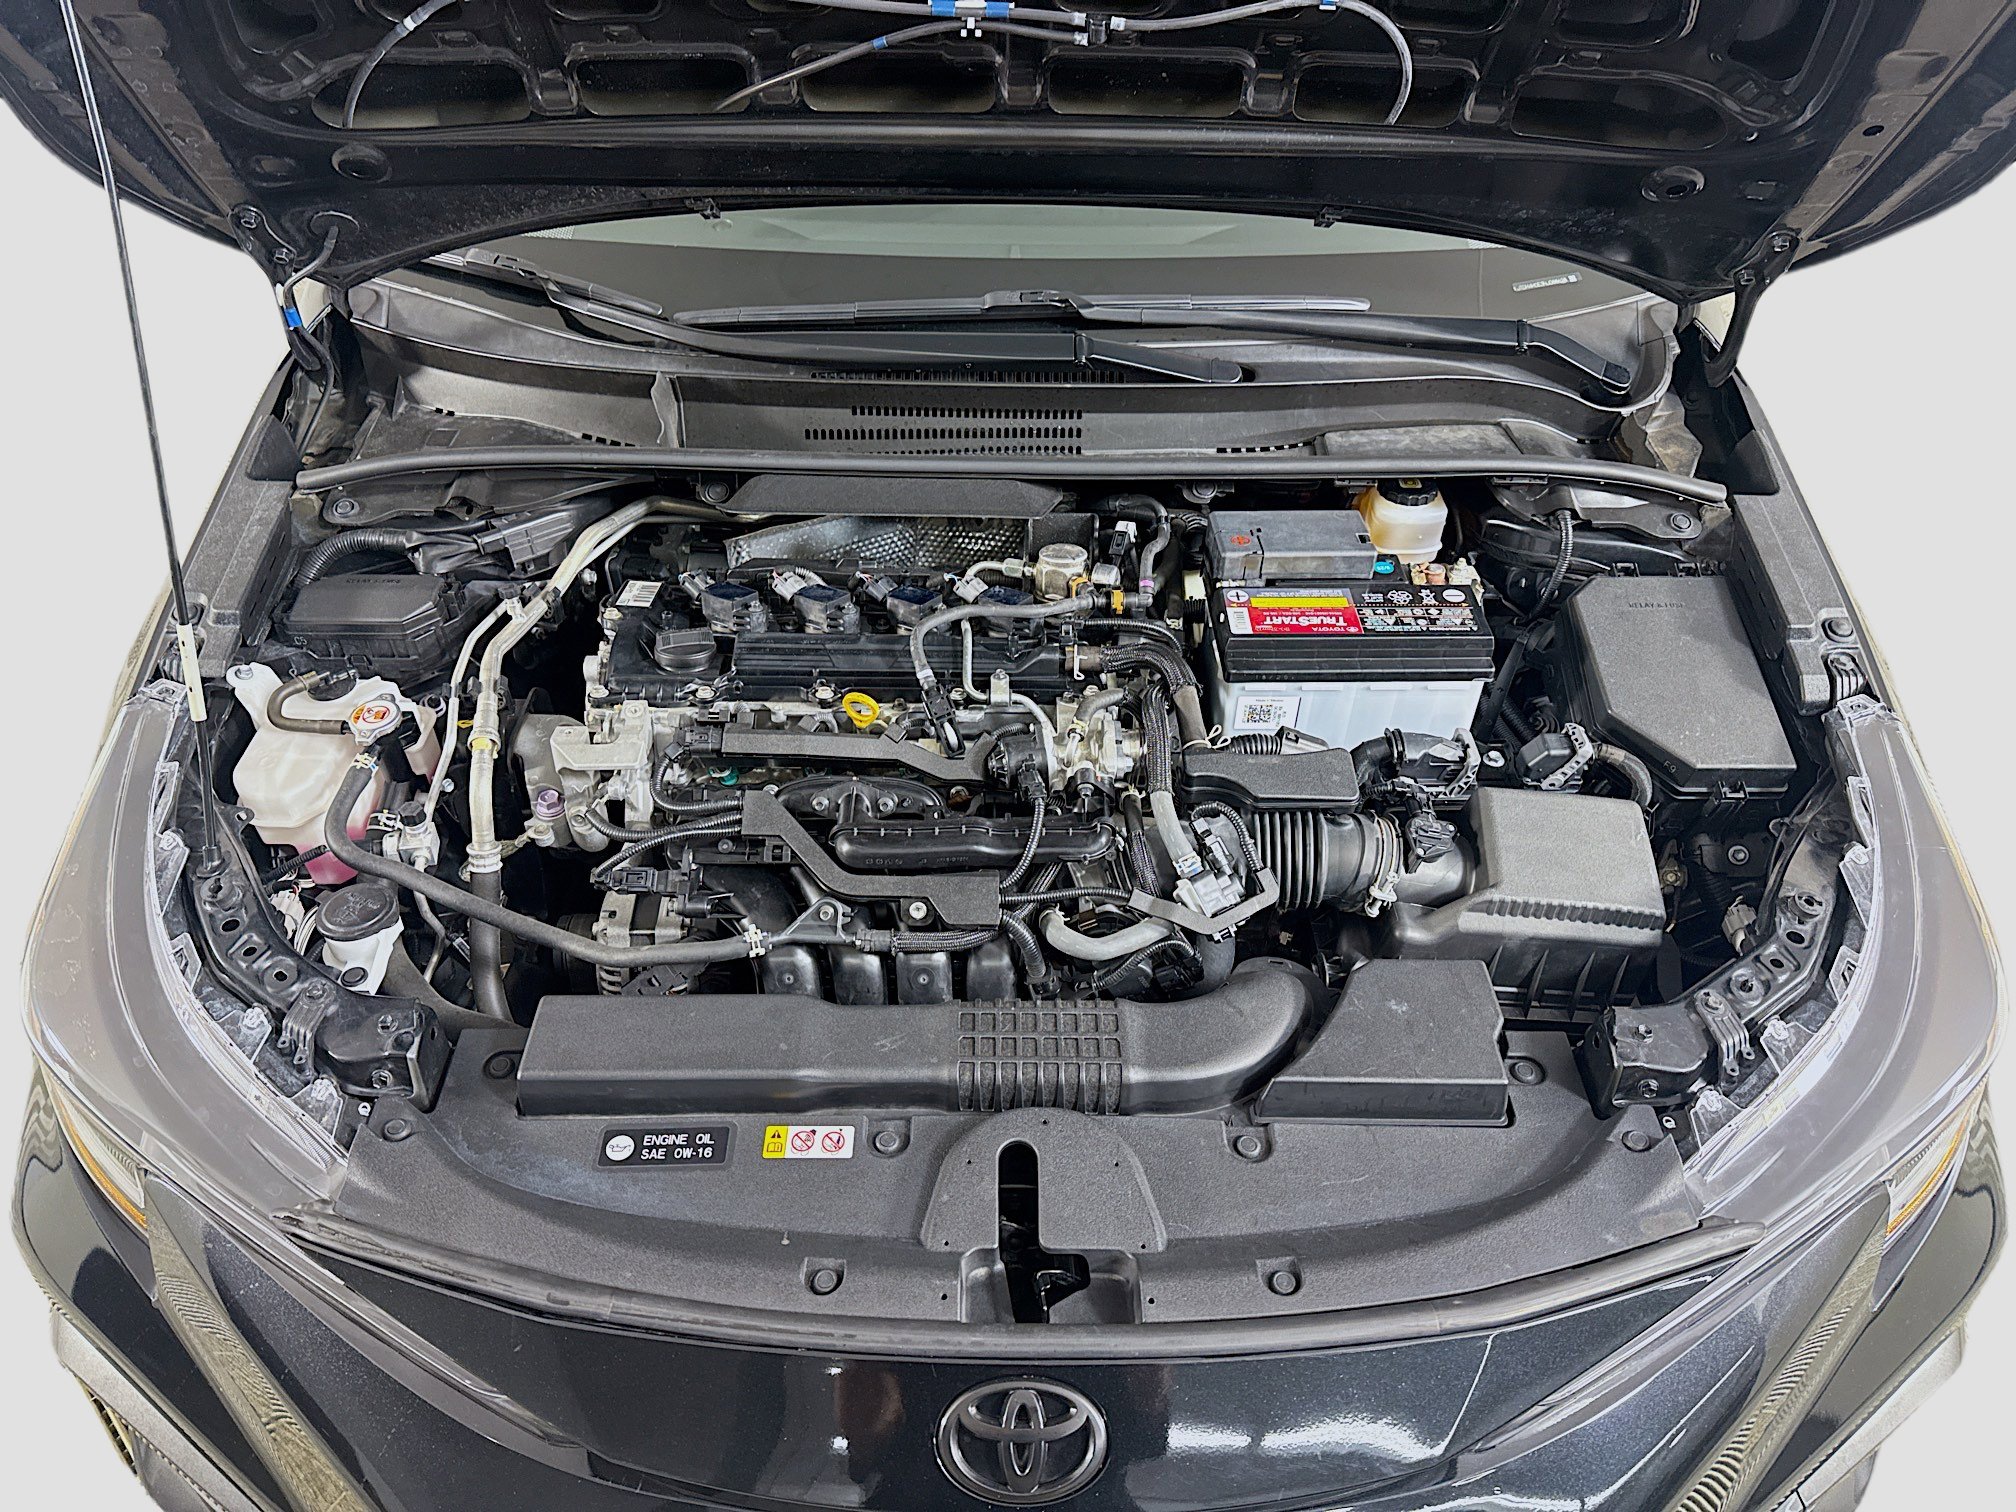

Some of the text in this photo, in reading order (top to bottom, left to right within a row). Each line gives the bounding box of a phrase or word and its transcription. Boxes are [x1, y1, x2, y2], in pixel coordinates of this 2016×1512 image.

[1263, 616, 1348, 627] TRUESTART
[643, 1133, 715, 1146] ENGINE OIL
[640, 1147, 713, 1160] SAE 0W-16
